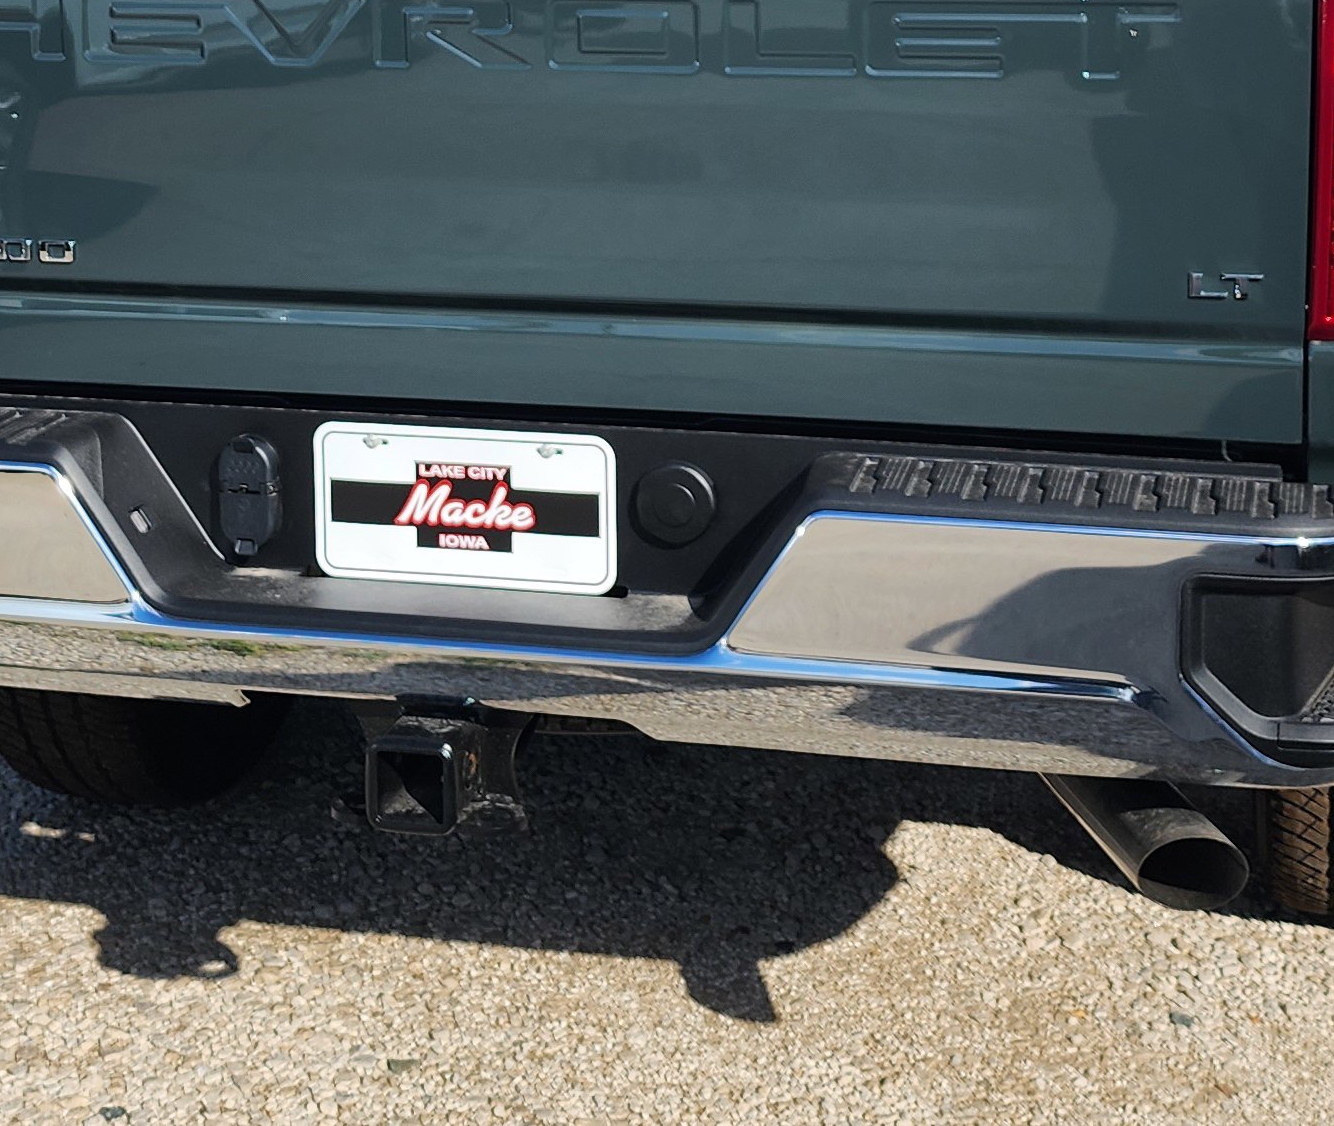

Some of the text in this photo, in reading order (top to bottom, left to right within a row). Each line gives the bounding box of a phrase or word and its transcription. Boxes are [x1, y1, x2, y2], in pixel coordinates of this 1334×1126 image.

[1188, 271, 1264, 300] LT
[418, 463, 507, 481] LAKE CITY
[395, 480, 536, 531] Macke
[439, 533, 490, 550] IOWA
